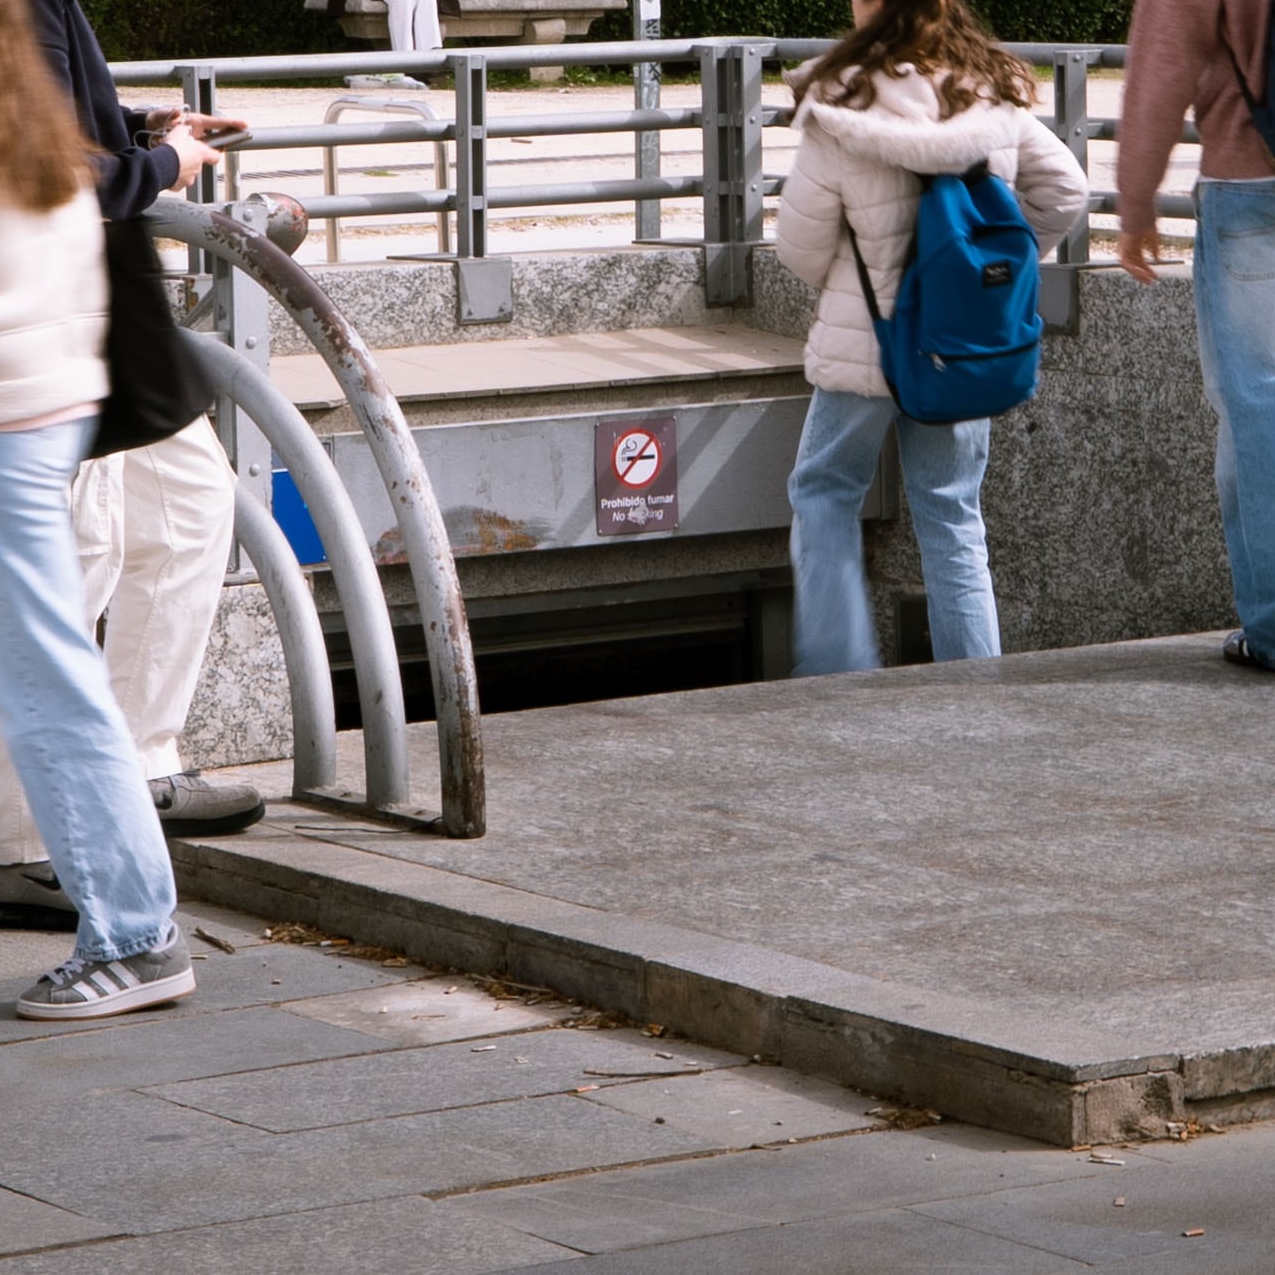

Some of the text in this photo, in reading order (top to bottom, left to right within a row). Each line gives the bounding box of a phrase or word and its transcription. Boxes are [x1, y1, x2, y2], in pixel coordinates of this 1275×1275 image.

[600, 494, 675, 510] Prohibido fumar
[612, 511, 626, 522] No
